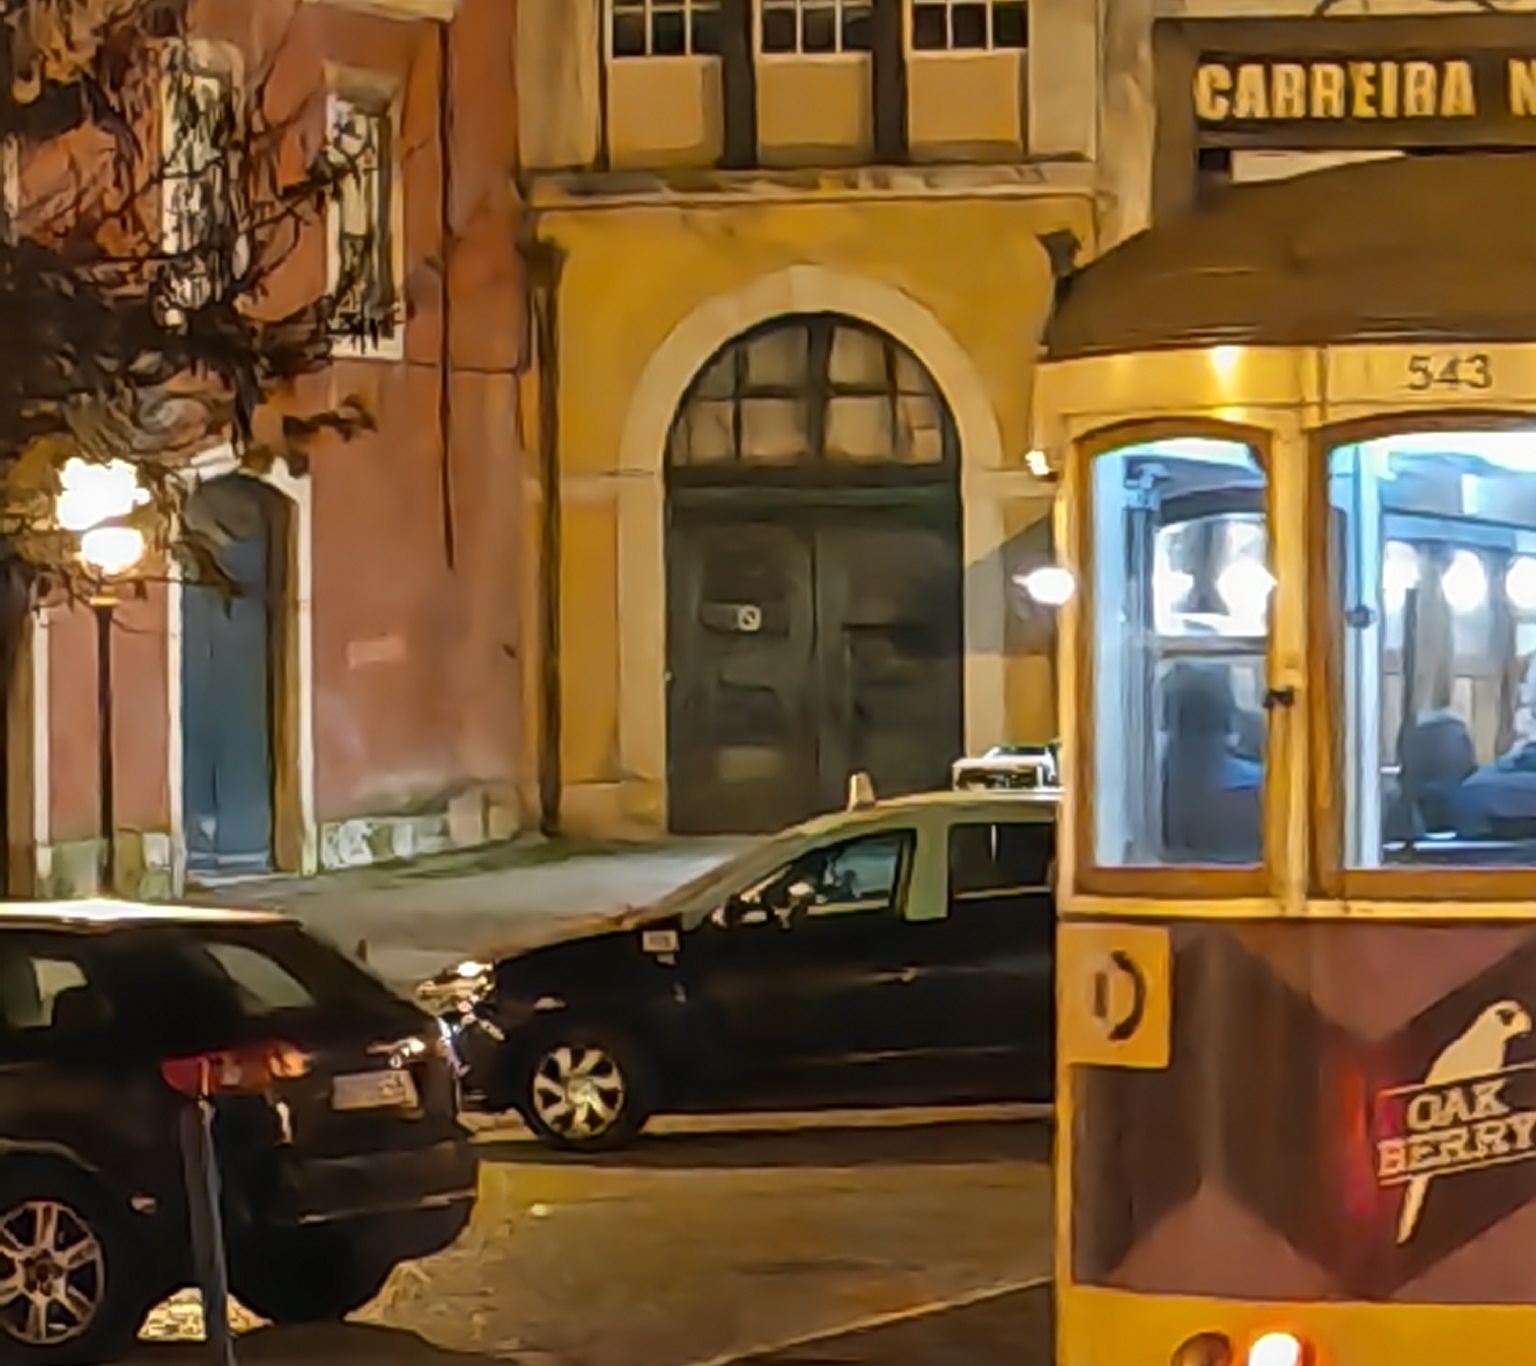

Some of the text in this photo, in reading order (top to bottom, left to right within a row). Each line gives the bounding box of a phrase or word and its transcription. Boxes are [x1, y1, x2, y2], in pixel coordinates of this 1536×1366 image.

[1193, 59, 1477, 121] CARREIRA
[1407, 353, 1493, 391] 543
[1407, 1078, 1511, 1131] OAK
